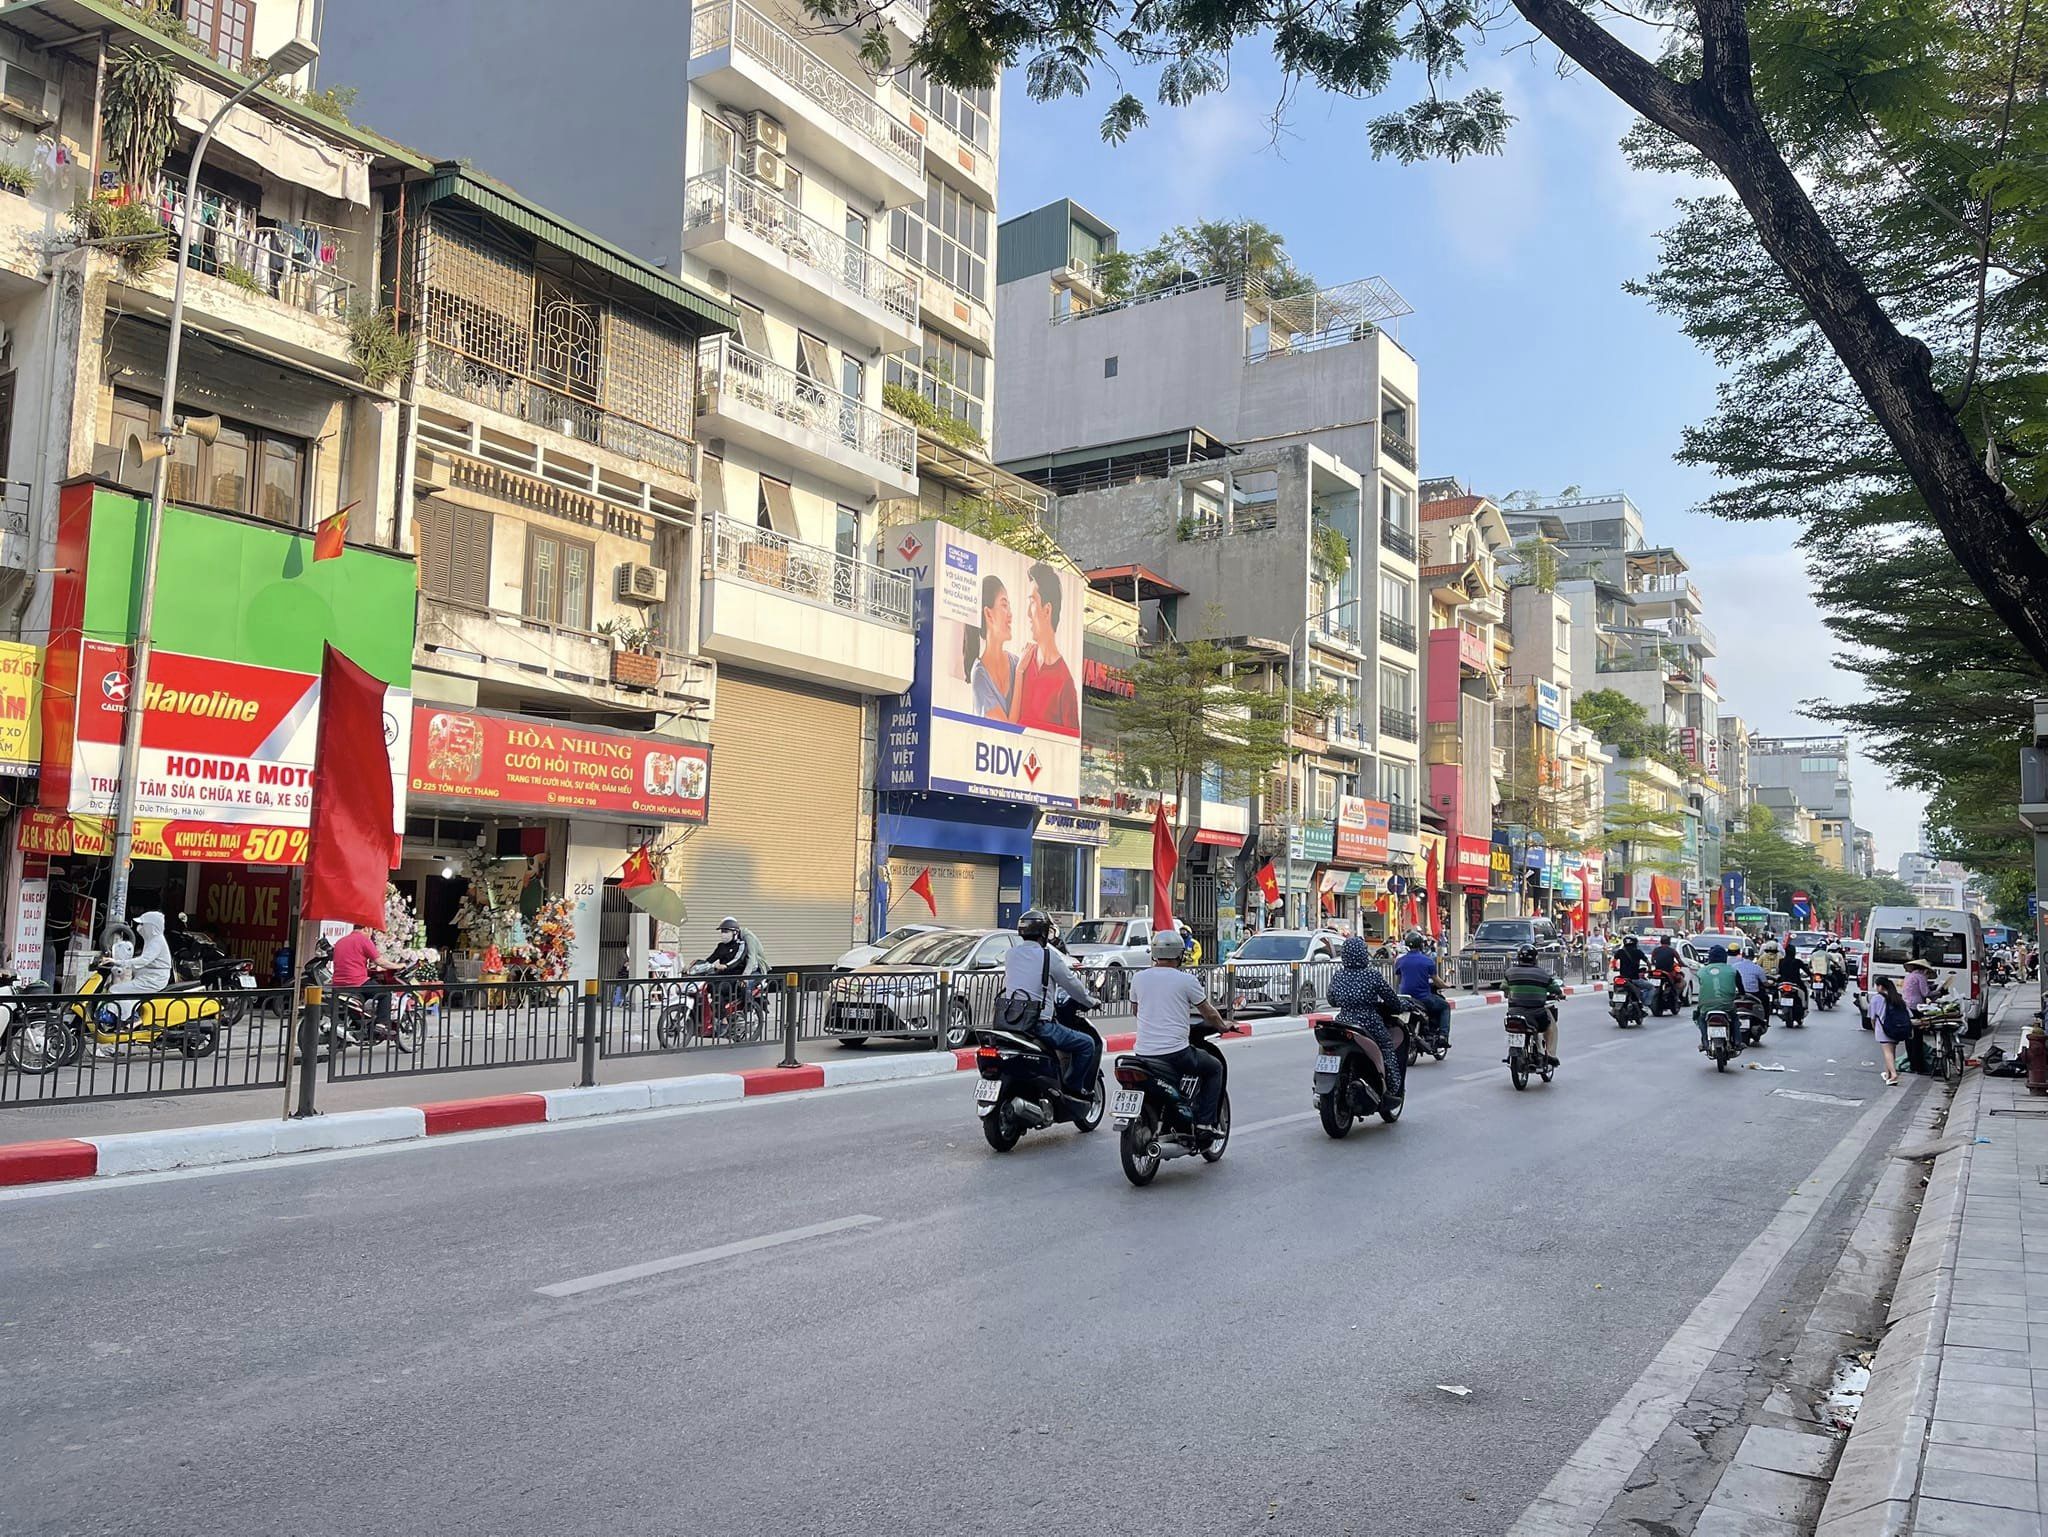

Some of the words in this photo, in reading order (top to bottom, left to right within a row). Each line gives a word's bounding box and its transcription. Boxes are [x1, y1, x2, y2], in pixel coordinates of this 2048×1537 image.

[144, 681, 260, 722] Havoline
[899, 692, 912, 708] VÀ
[892, 711, 918, 727] PHÁT
[507, 728, 555, 750] HÒA
[561, 737, 632, 760] NHUNG
[890, 728, 919, 746] TRIỂN
[166, 755, 250, 783] HONDA
[505, 753, 541, 770] CƯỚI
[545, 755, 569, 773] HỎI
[572, 761, 608, 779] TRỌN
[611, 764, 634, 781] GÓI
[893, 749, 915, 768] VIỆT
[976, 741, 1022, 777] BIDV
[506, 774, 529, 784] TRANG
[891, 770, 914, 784] NAM
[140, 779, 167, 797] TÂM
[171, 780, 195, 799] SỬA
[199, 784, 233, 802] CHỮA
[237, 789, 251, 803] XE
[255, 791, 274, 806] GA,
[277, 793, 291, 806] XE
[294, 790, 309, 808] SỐ
[423, 782, 436, 791] 225
[438, 782, 455, 793] TÔN
[455, 784, 472, 795] ĐỨC
[56, 821, 70, 852] SỐ
[175, 829, 218, 849] KHUYẾN
[220, 833, 241, 851] MẠI
[206, 871, 246, 924] SỬA
[252, 886, 281, 927] XE
[574, 883, 594, 895] 225
